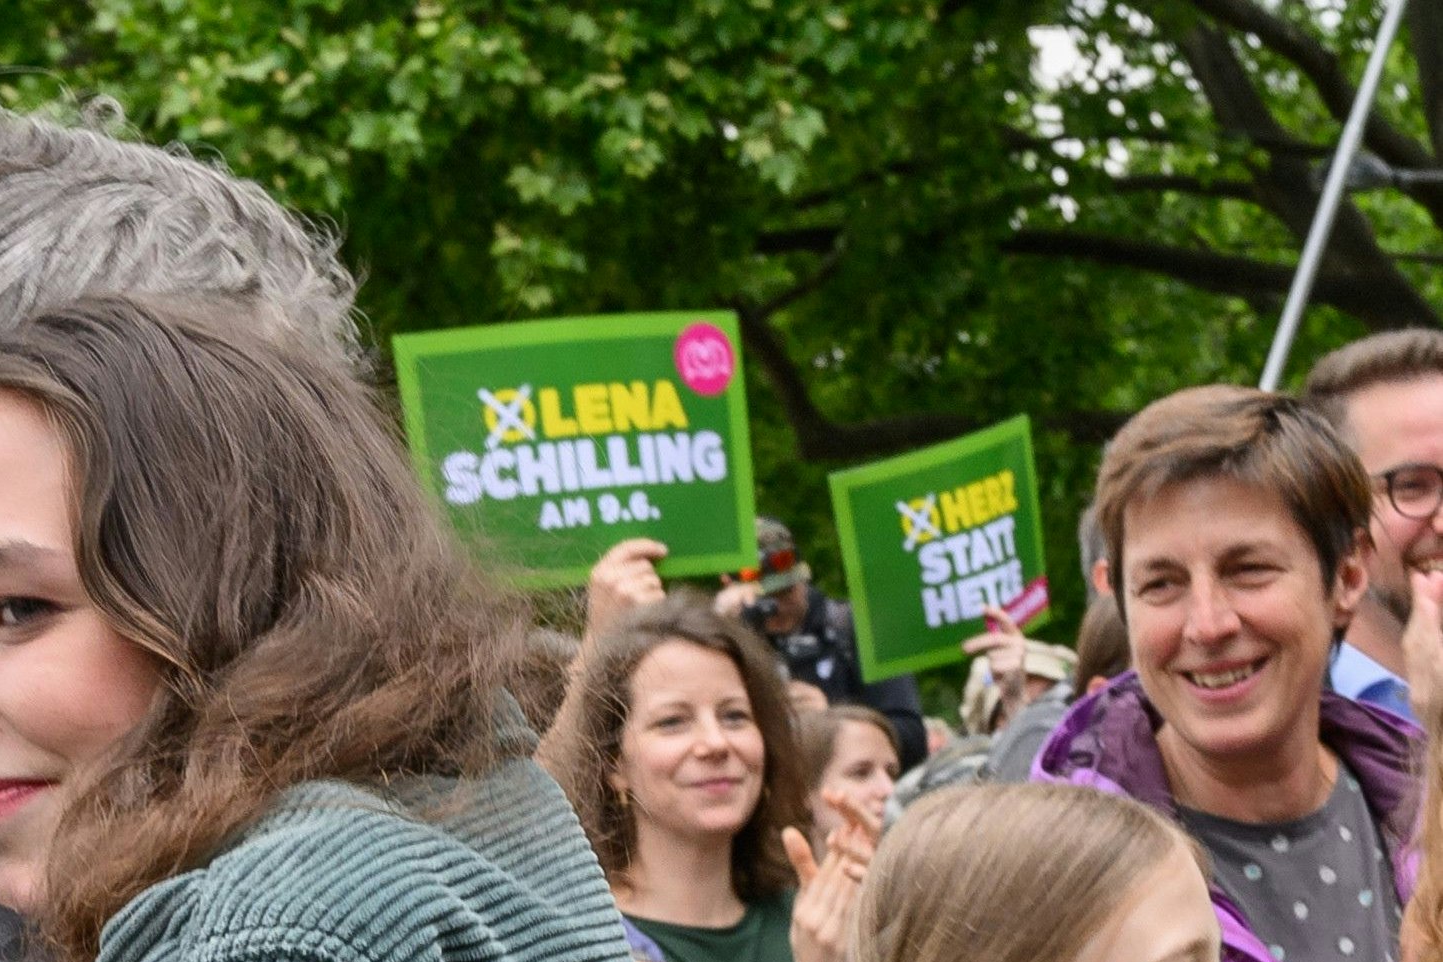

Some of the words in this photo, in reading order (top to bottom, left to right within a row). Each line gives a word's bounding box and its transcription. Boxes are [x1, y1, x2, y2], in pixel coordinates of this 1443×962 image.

[539, 379, 688, 438] LENA
[442, 430, 727, 505] SCHILLING
[539, 497, 591, 530] AM
[918, 515, 1015, 584] STATT
